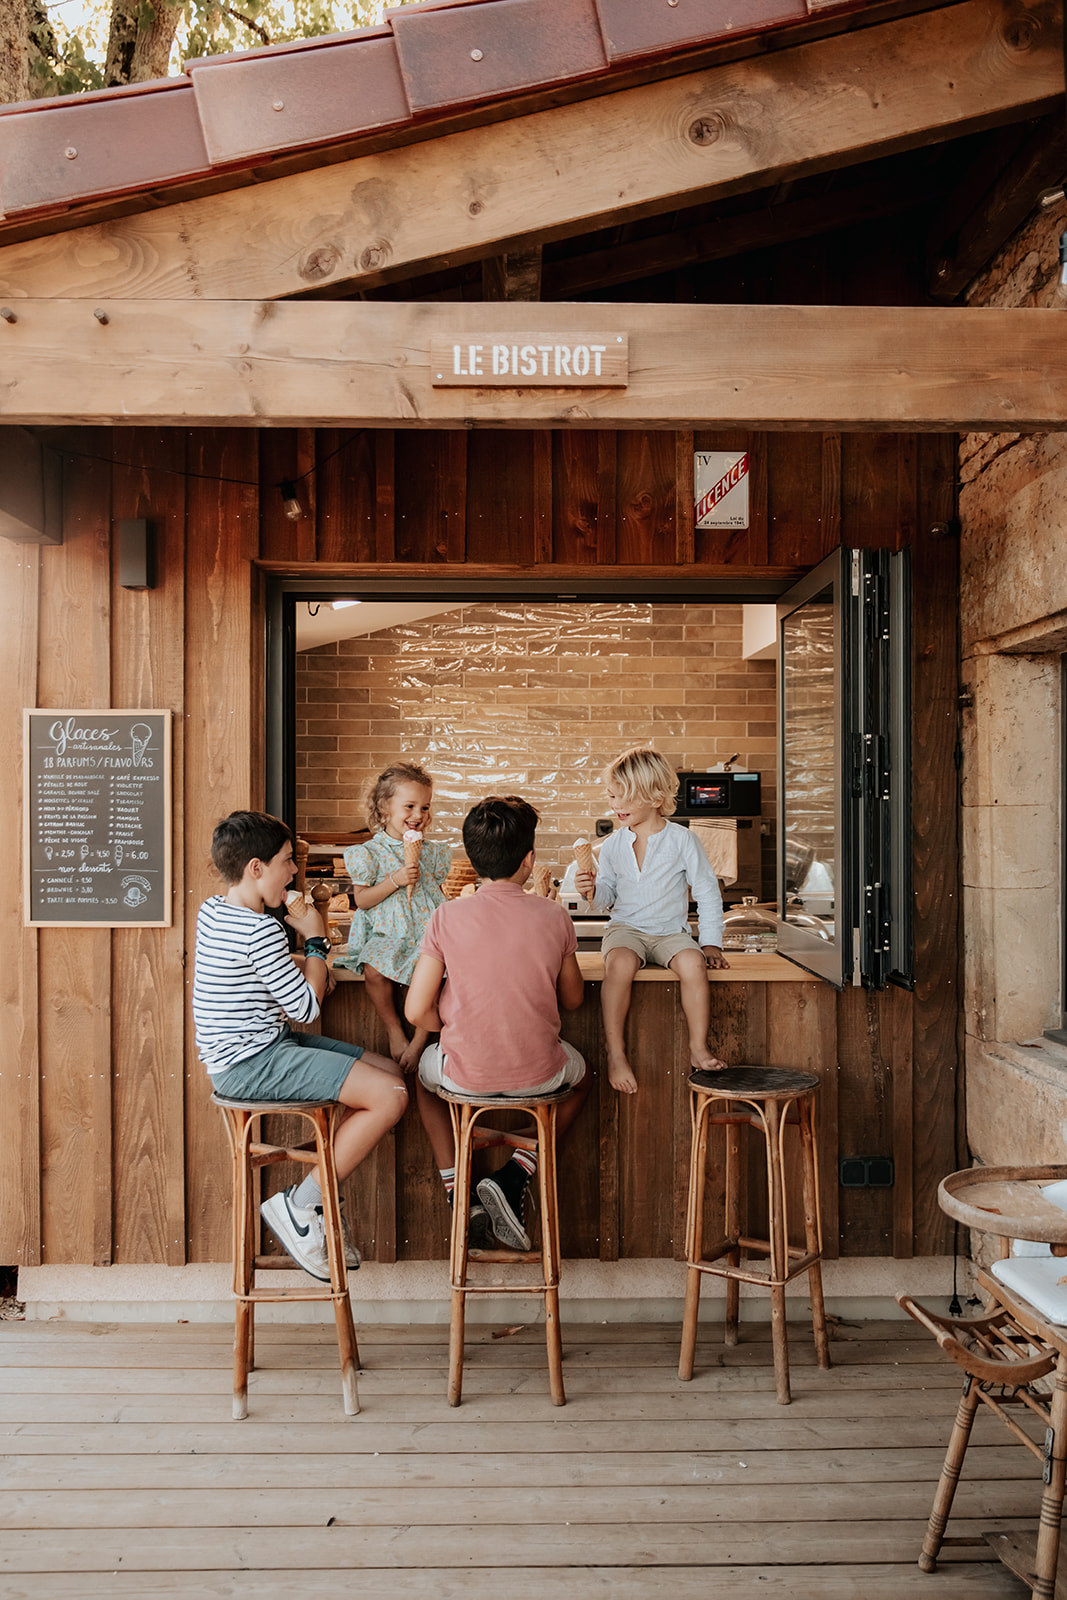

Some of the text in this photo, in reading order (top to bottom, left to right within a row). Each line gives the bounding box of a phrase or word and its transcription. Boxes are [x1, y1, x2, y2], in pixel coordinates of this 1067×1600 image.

[453, 345, 607, 377] LE BISTROT
[697, 455, 711, 466] IV
[696, 458, 745, 521] LICENCE
[49, 717, 119, 756] Glaces
[73, 741, 122, 752] artisanales
[43, 757, 55, 769] 18
[78, 862, 114, 873] desserts
